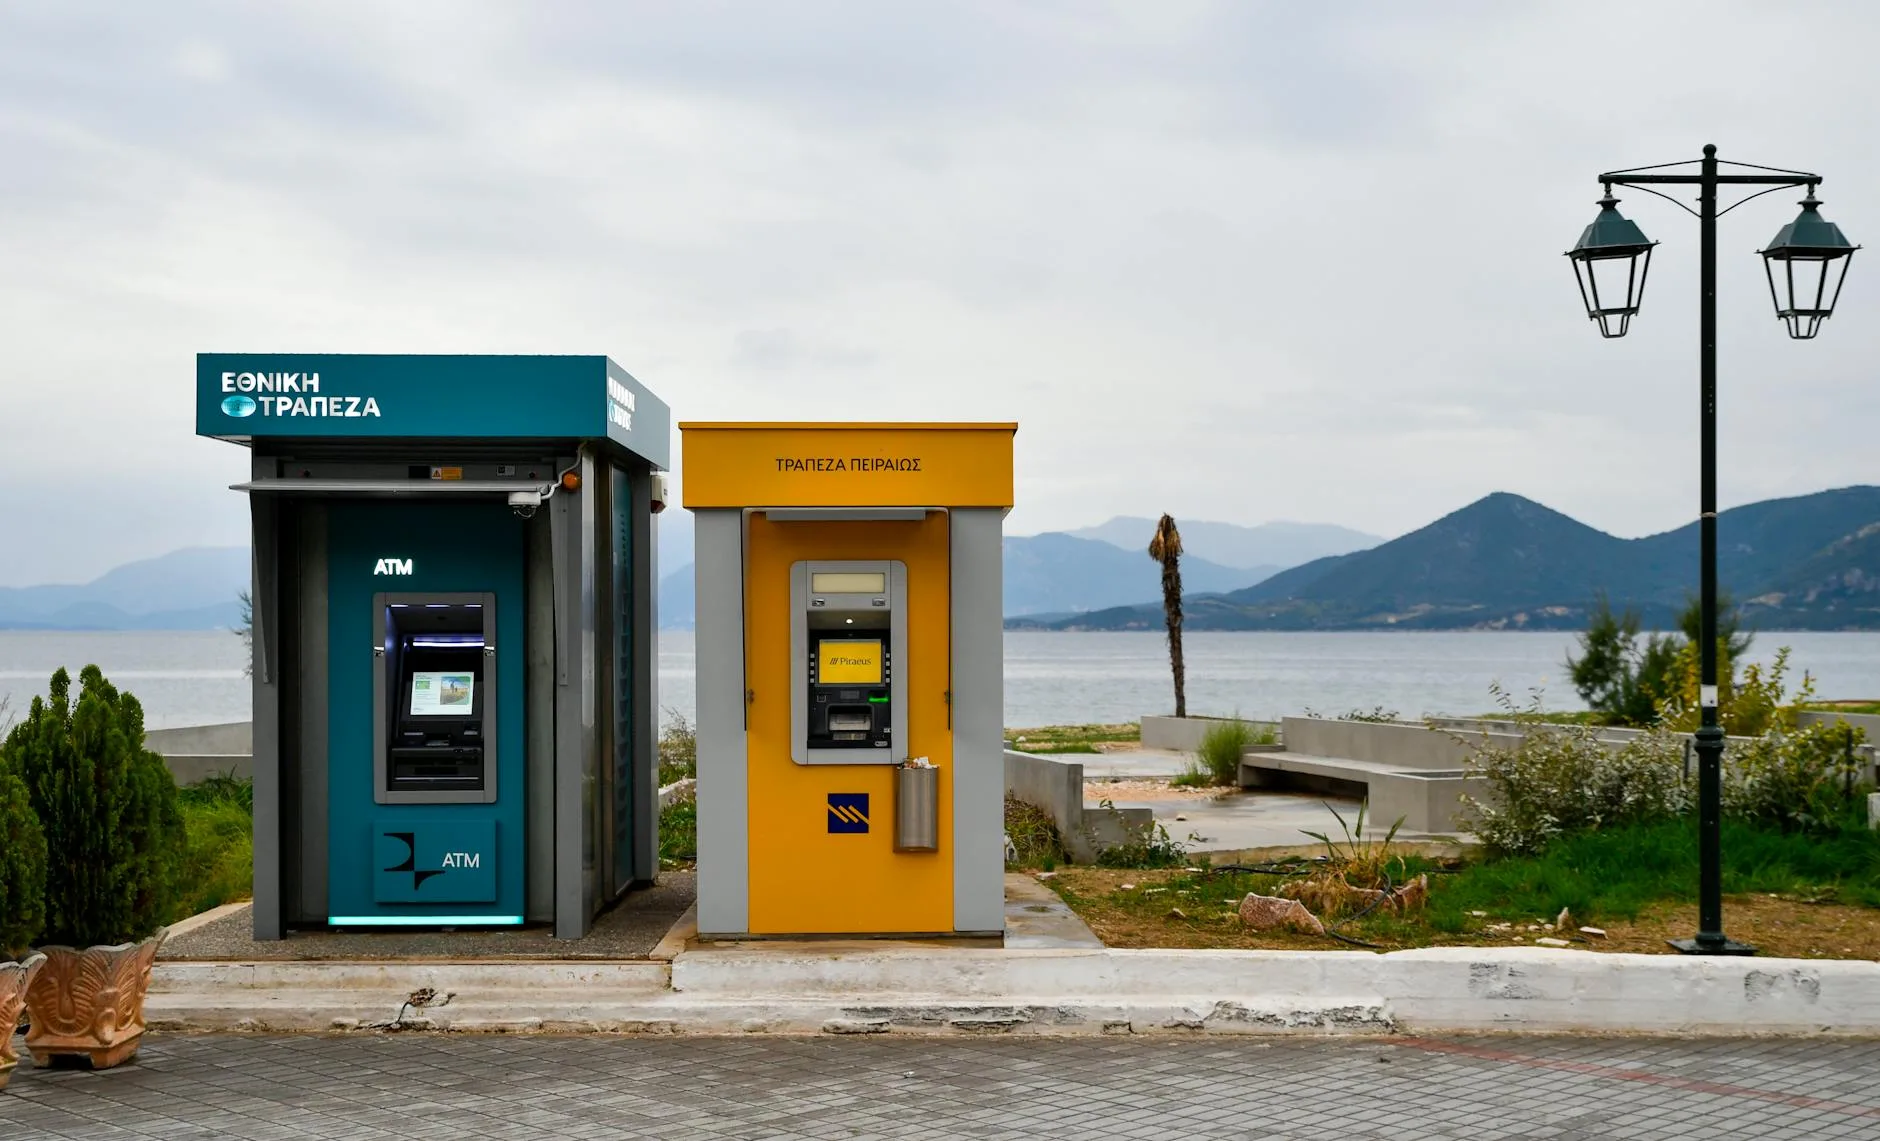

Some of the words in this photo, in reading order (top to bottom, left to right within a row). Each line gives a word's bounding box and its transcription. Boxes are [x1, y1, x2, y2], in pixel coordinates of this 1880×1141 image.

[221, 372, 320, 393] ΕΘΝΙΚΗ
[258, 396, 381, 417] ΤΡΑΠΕΖΑ
[776, 458, 847, 472] ΤΡΑΠΕΖΑ
[850, 458, 922, 472] ΠΕΙΡΑΙΩΣ
[373, 558, 413, 576] ATM
[840, 657, 872, 666] Piraeus
[441, 852, 480, 868] ATM
